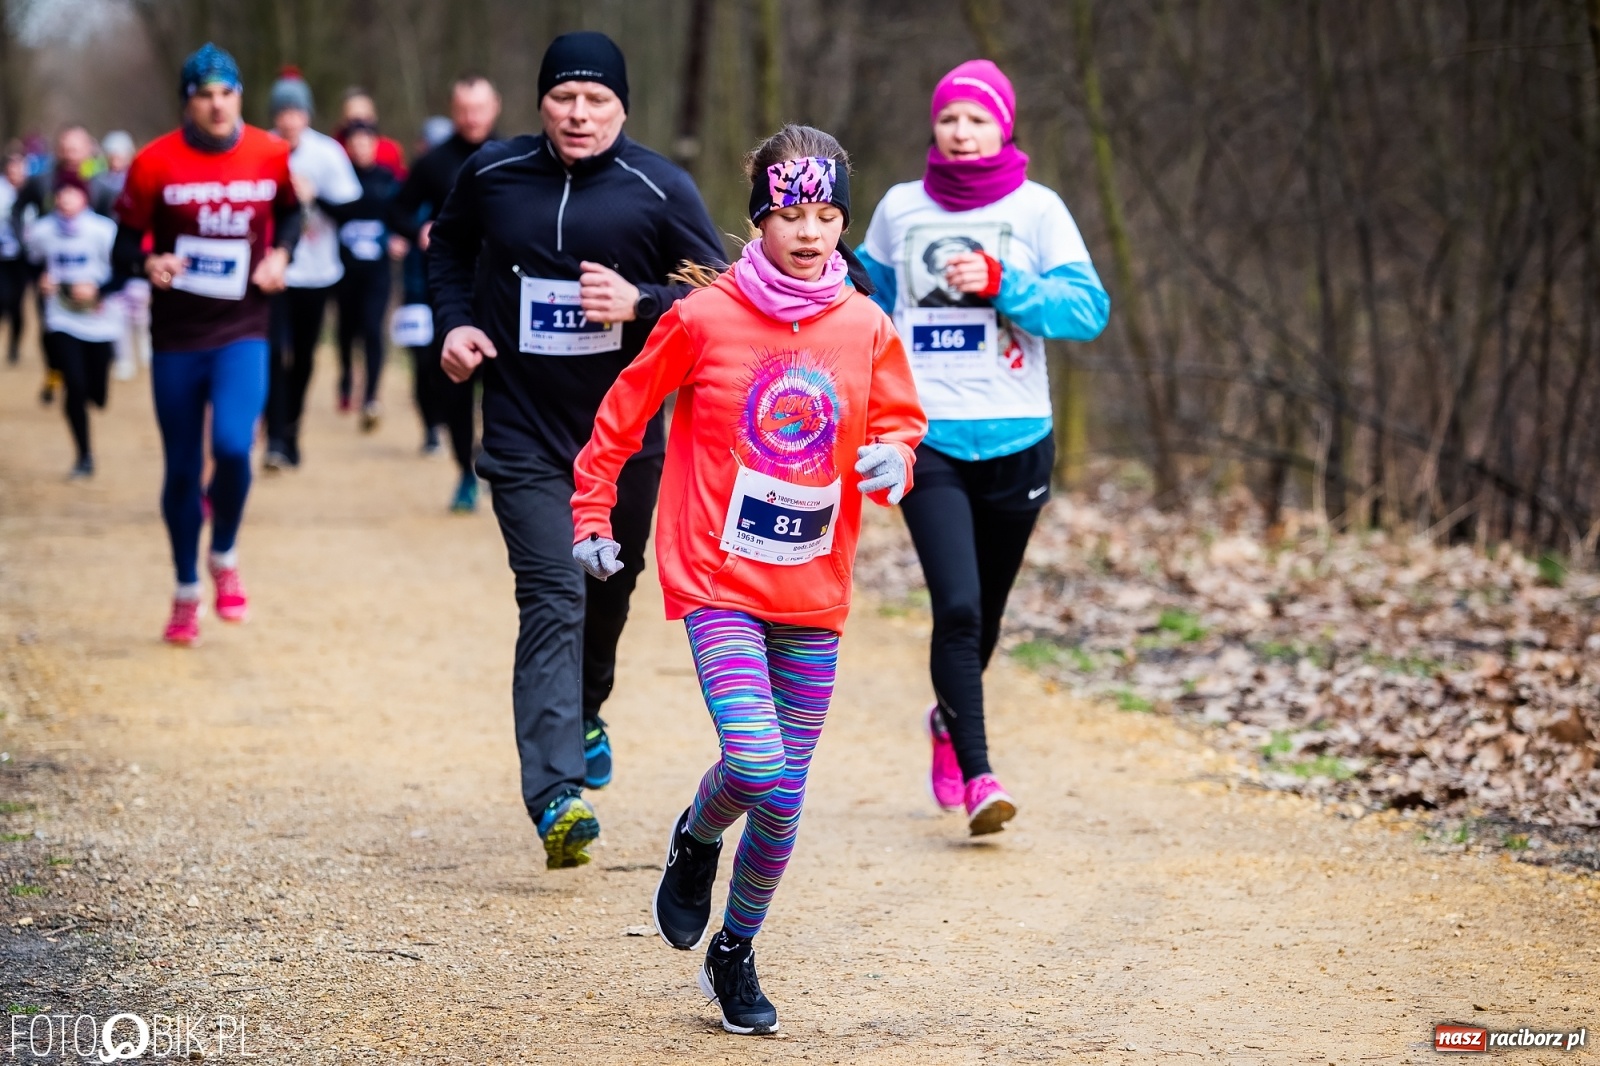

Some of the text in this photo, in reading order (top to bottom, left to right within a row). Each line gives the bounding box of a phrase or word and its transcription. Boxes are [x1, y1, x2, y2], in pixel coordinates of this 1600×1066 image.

[553, 309, 587, 328] 117
[930, 329, 965, 348] 166
[772, 396, 816, 413] NIKE
[801, 417, 822, 430] SB
[773, 515, 802, 536] 81
[736, 531, 764, 546] 1963 m
